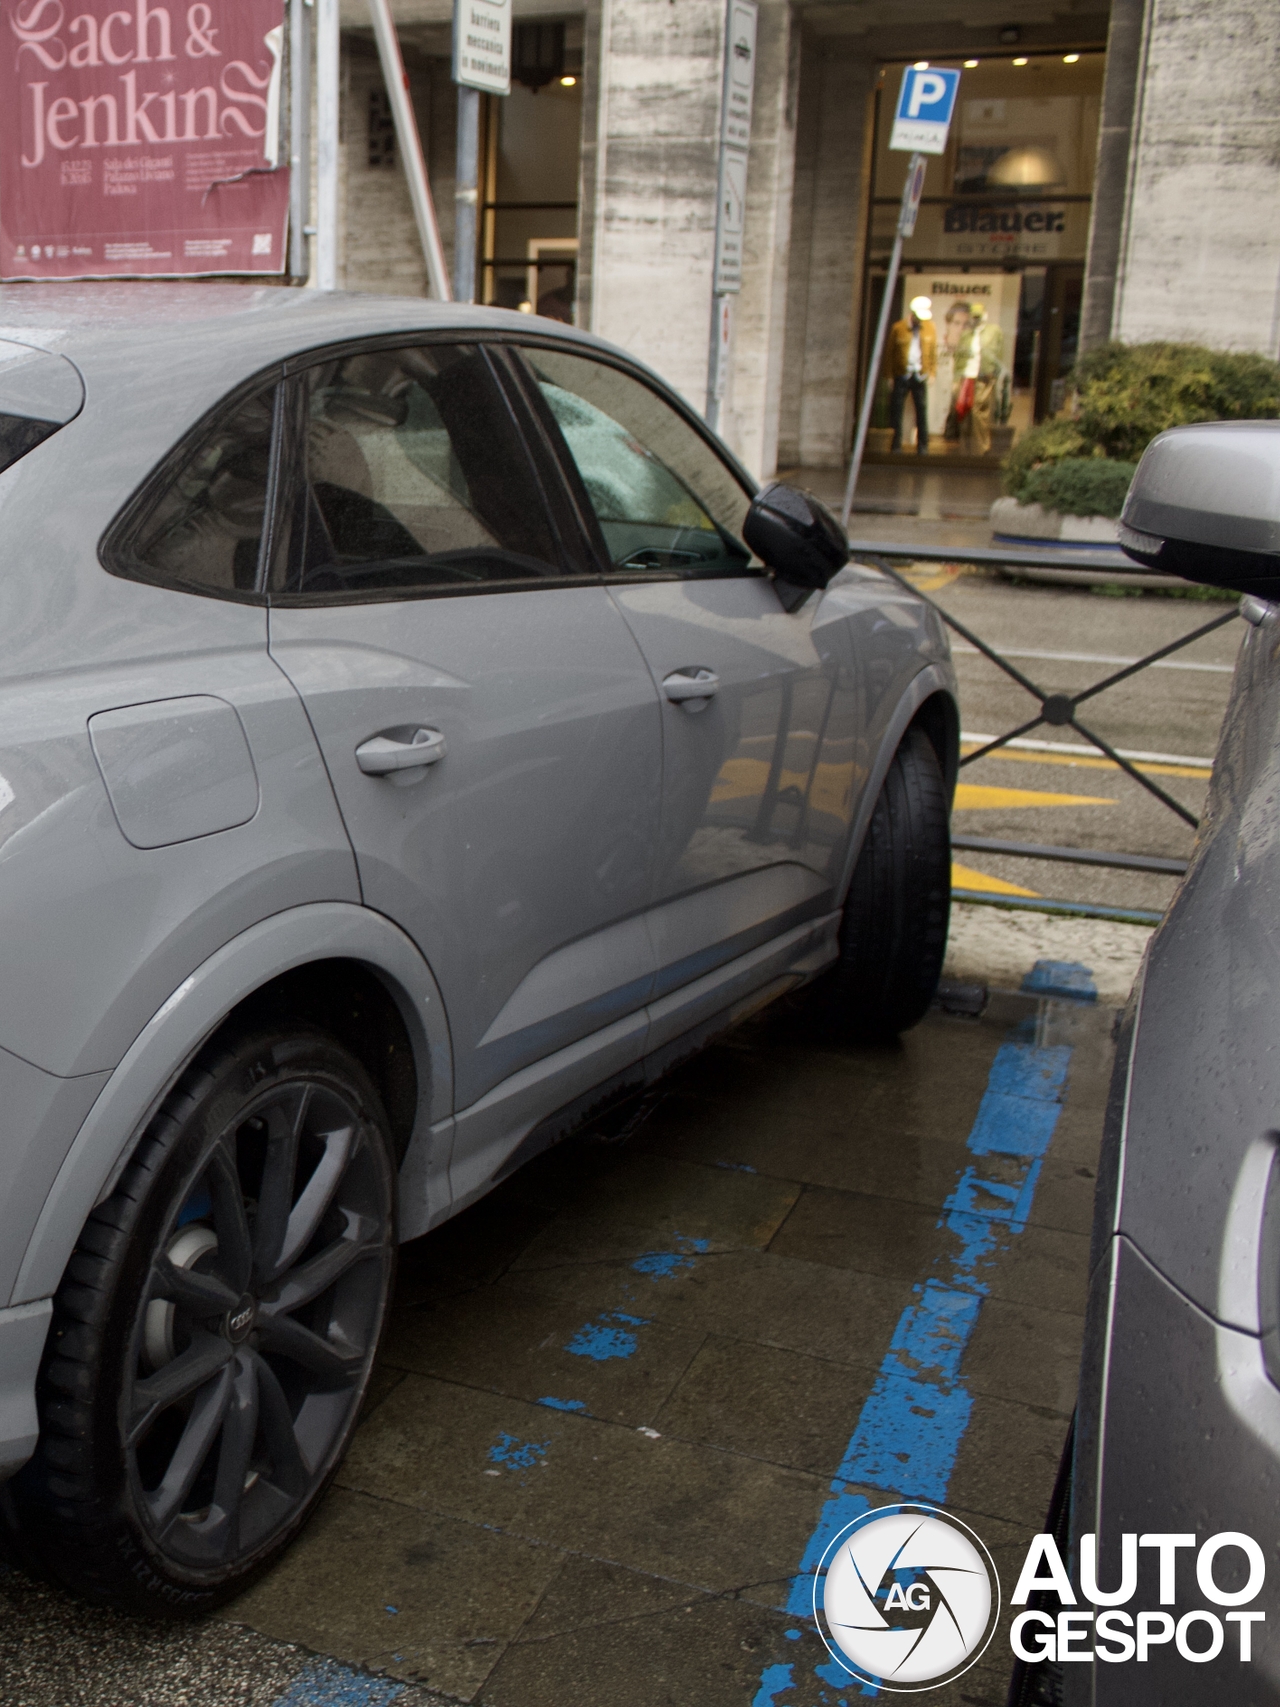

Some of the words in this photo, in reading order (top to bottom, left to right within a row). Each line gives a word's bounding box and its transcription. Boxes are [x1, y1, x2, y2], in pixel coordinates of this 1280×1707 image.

[185, 3, 221, 59] &
[470, 6, 501, 32] barriera
[466, 34, 503, 55] meccanica
[907, 72, 947, 118] P
